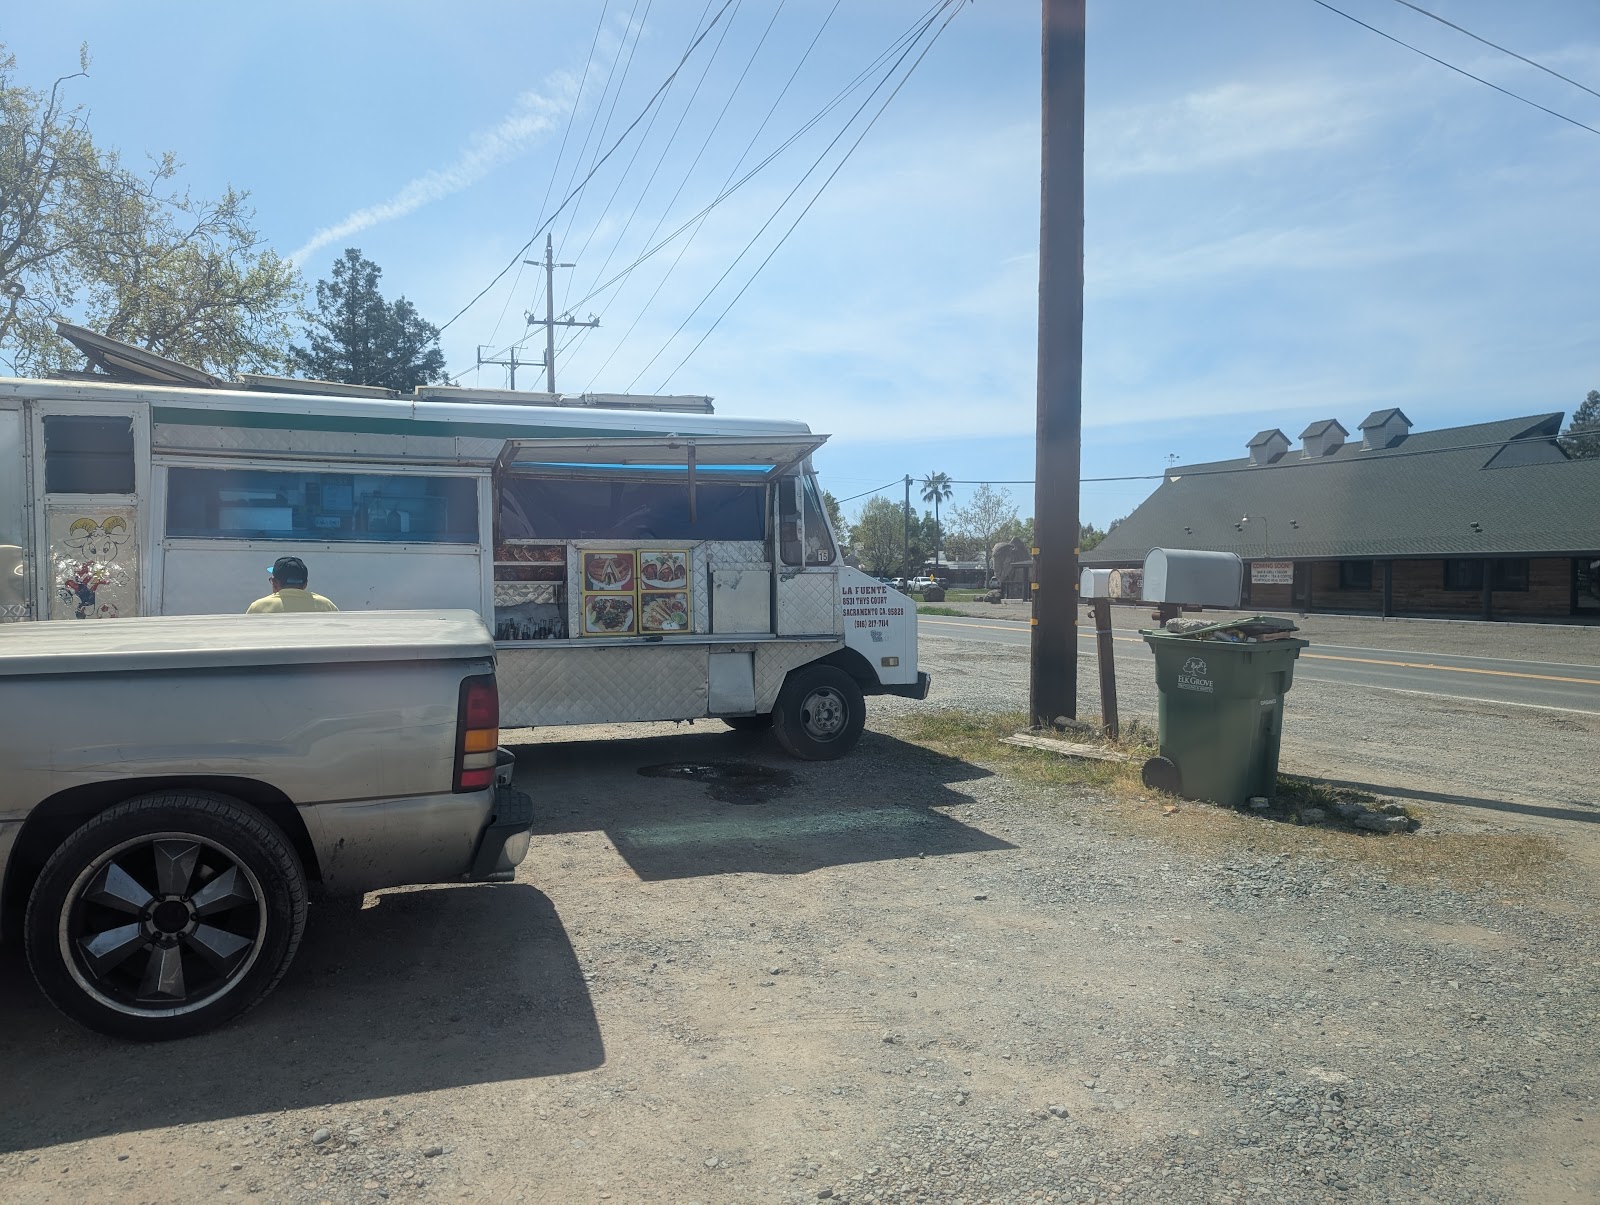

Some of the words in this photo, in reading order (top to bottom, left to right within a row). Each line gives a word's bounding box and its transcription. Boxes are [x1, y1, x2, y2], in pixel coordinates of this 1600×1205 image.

[842, 586, 853, 595] LA
[855, 586, 887, 595] FUENTE
[870, 596, 888, 605] COURT
[842, 608, 878, 617] SACRAMENTO
[854, 619, 867, 629] (916)
[1177, 674, 1190, 684] ELK
[1190, 677, 1214, 687] GROVE
